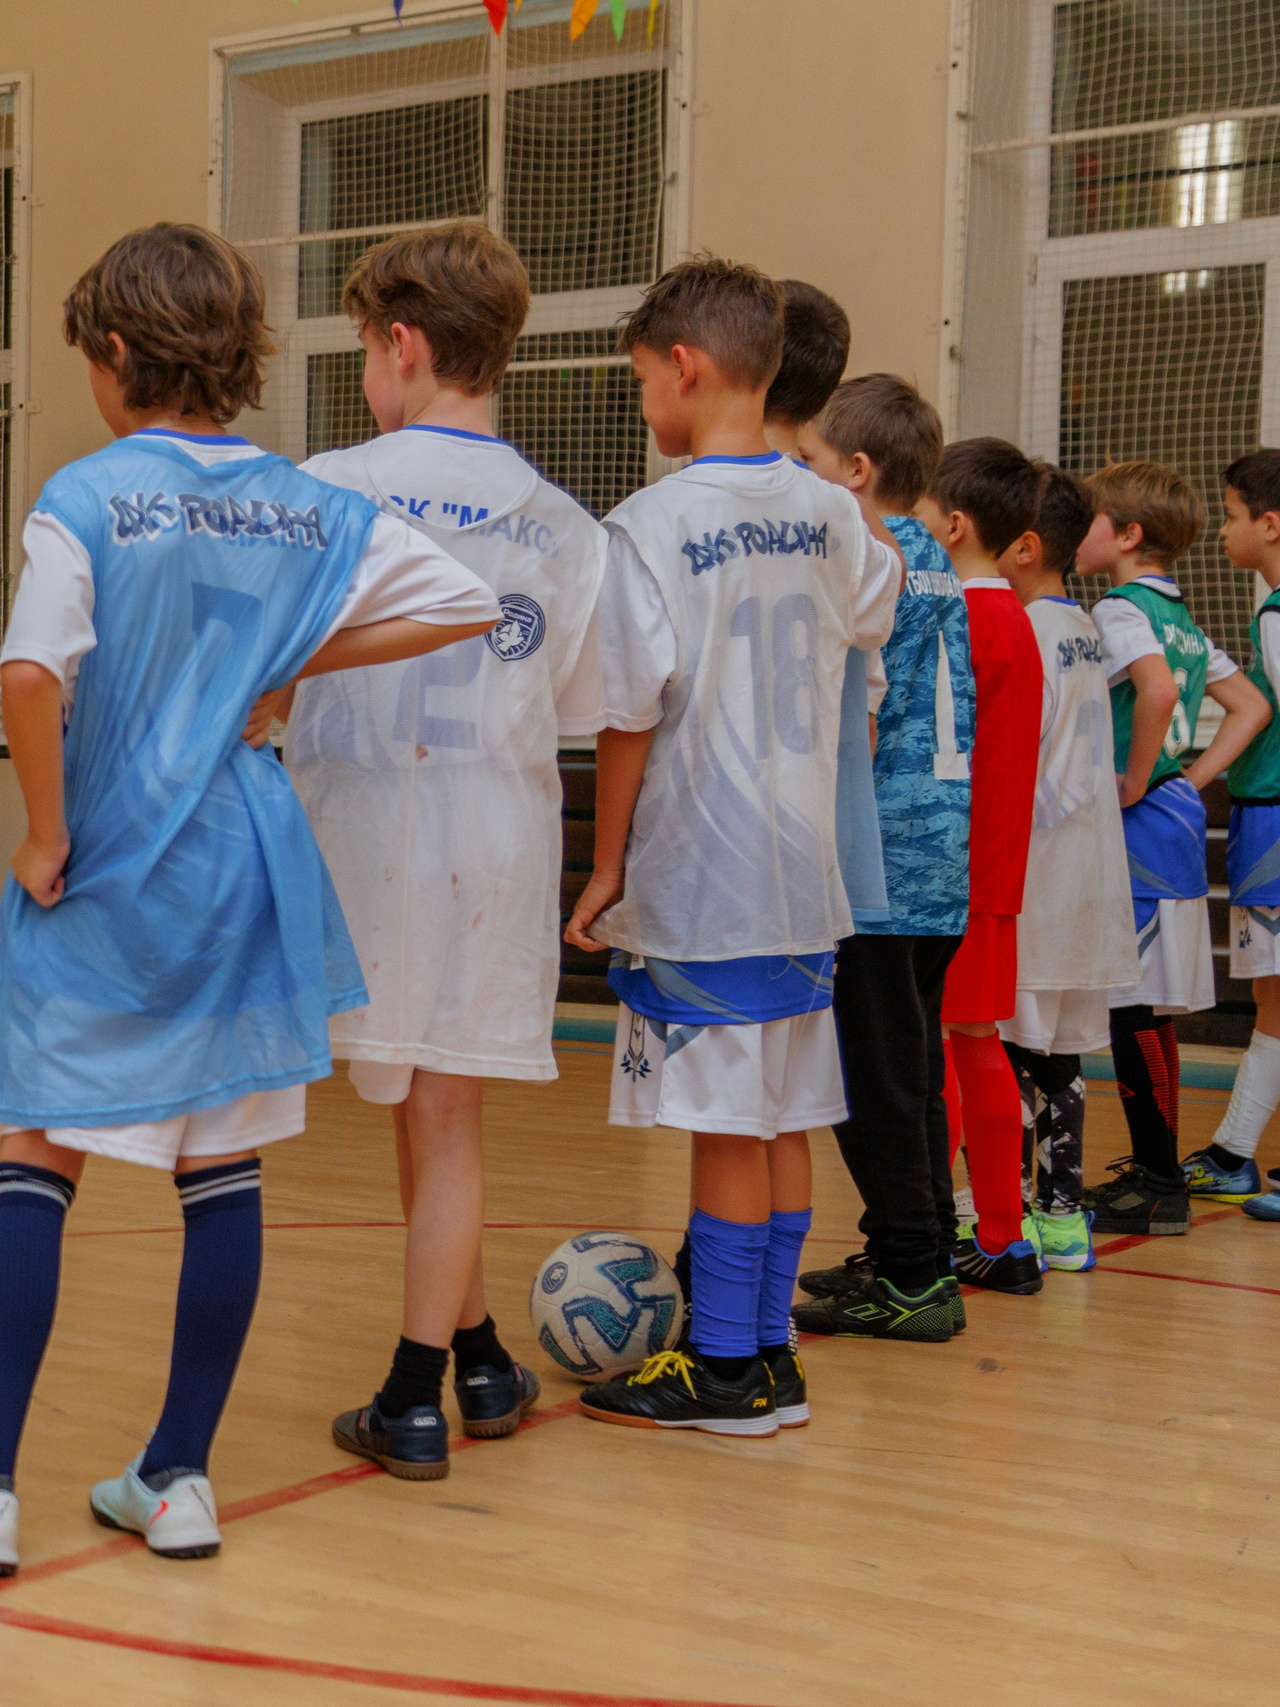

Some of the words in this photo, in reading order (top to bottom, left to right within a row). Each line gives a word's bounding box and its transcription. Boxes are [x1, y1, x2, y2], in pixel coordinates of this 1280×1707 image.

[730, 592, 819, 760] 18
[933, 629, 970, 780] 1
[752, 1397, 768, 1408] FN
